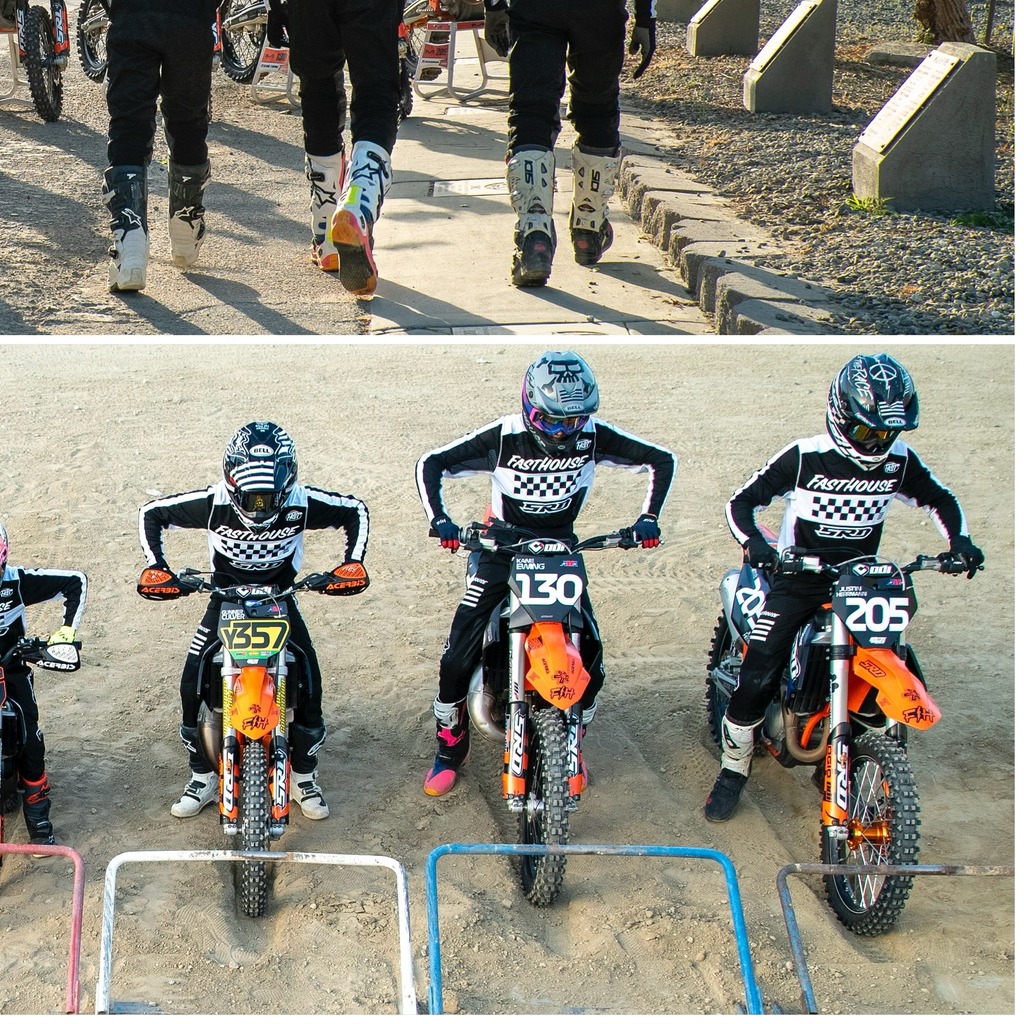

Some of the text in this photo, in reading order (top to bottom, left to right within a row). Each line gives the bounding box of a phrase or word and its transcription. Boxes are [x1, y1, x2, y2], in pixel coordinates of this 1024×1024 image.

[507, 455, 588, 473] FASTHOUSE
[806, 475, 897, 492] FASTHOUSE
[520, 499, 571, 513] SRD
[215, 526, 299, 541] FASTHOUSE
[815, 525, 872, 538] SRD
[326, 580, 365, 590] ACERBIS
[515, 573, 583, 606] 130
[846, 598, 909, 631] 205
[223, 622, 287, 650] Y357
[36, 660, 76, 670] ACERBIS
[860, 660, 886, 678] SRD
[511, 710, 526, 776] SRD
